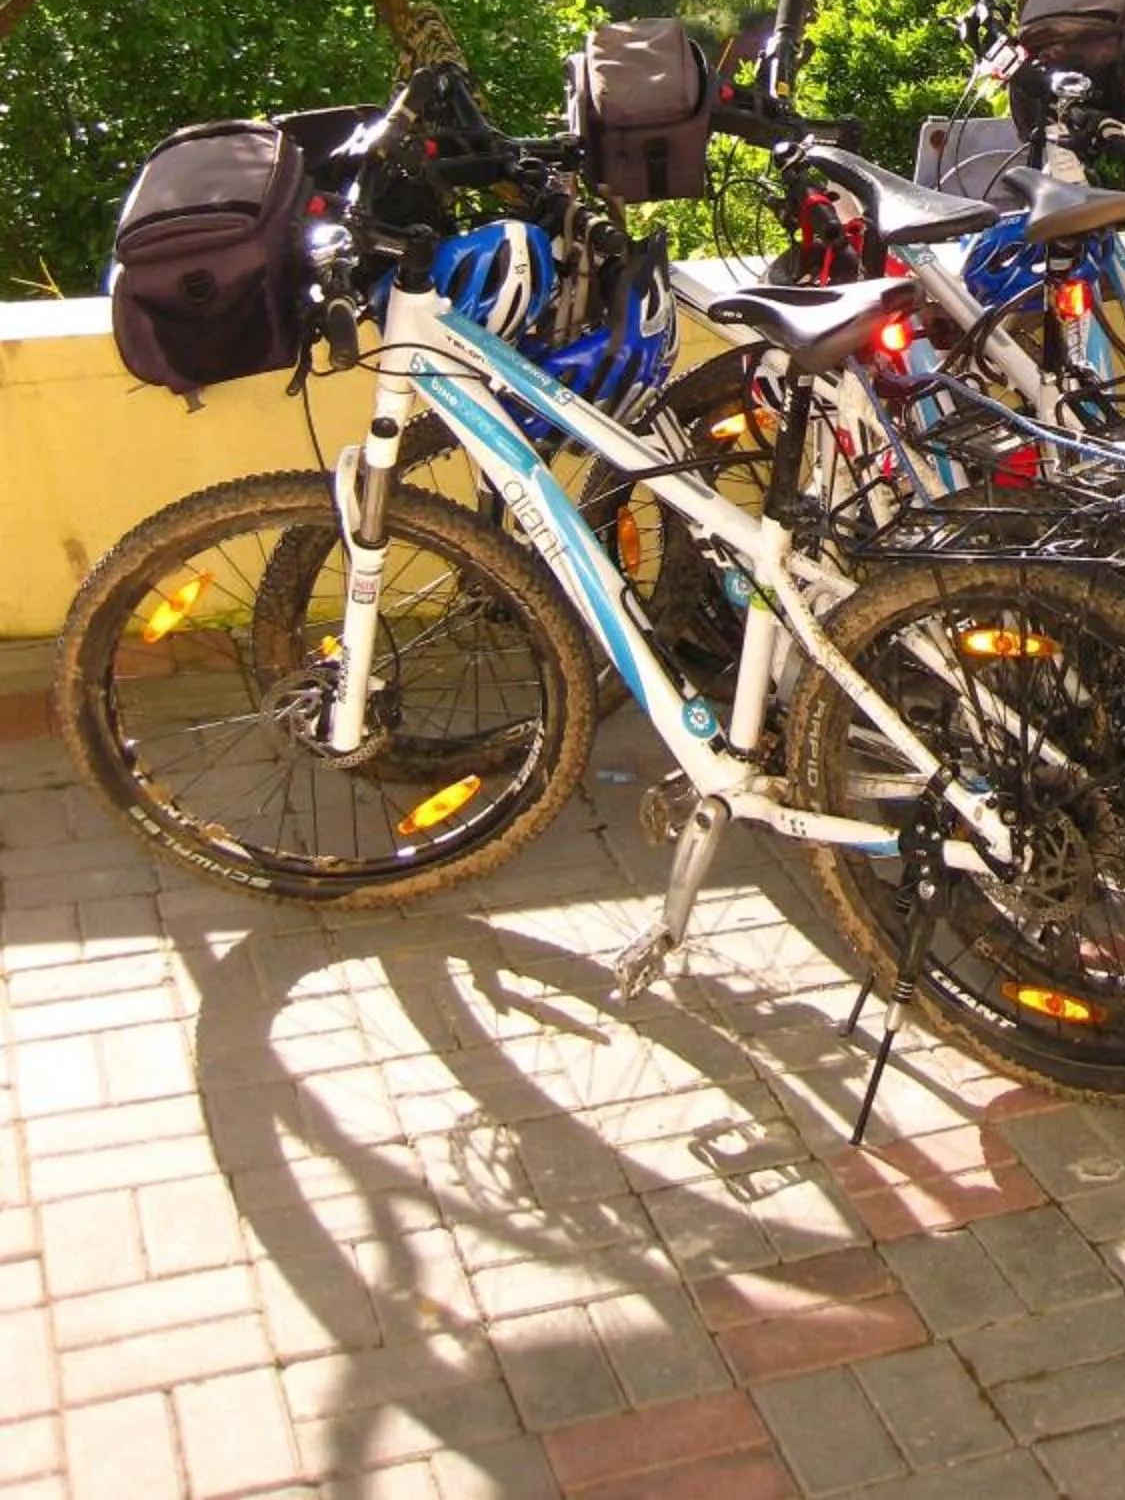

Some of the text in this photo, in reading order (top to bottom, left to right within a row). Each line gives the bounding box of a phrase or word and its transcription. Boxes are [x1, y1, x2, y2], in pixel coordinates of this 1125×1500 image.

[502, 480, 570, 565] giant
[129, 804, 273, 890] SCHWALBE
[930, 968, 1018, 1029] GIANT
